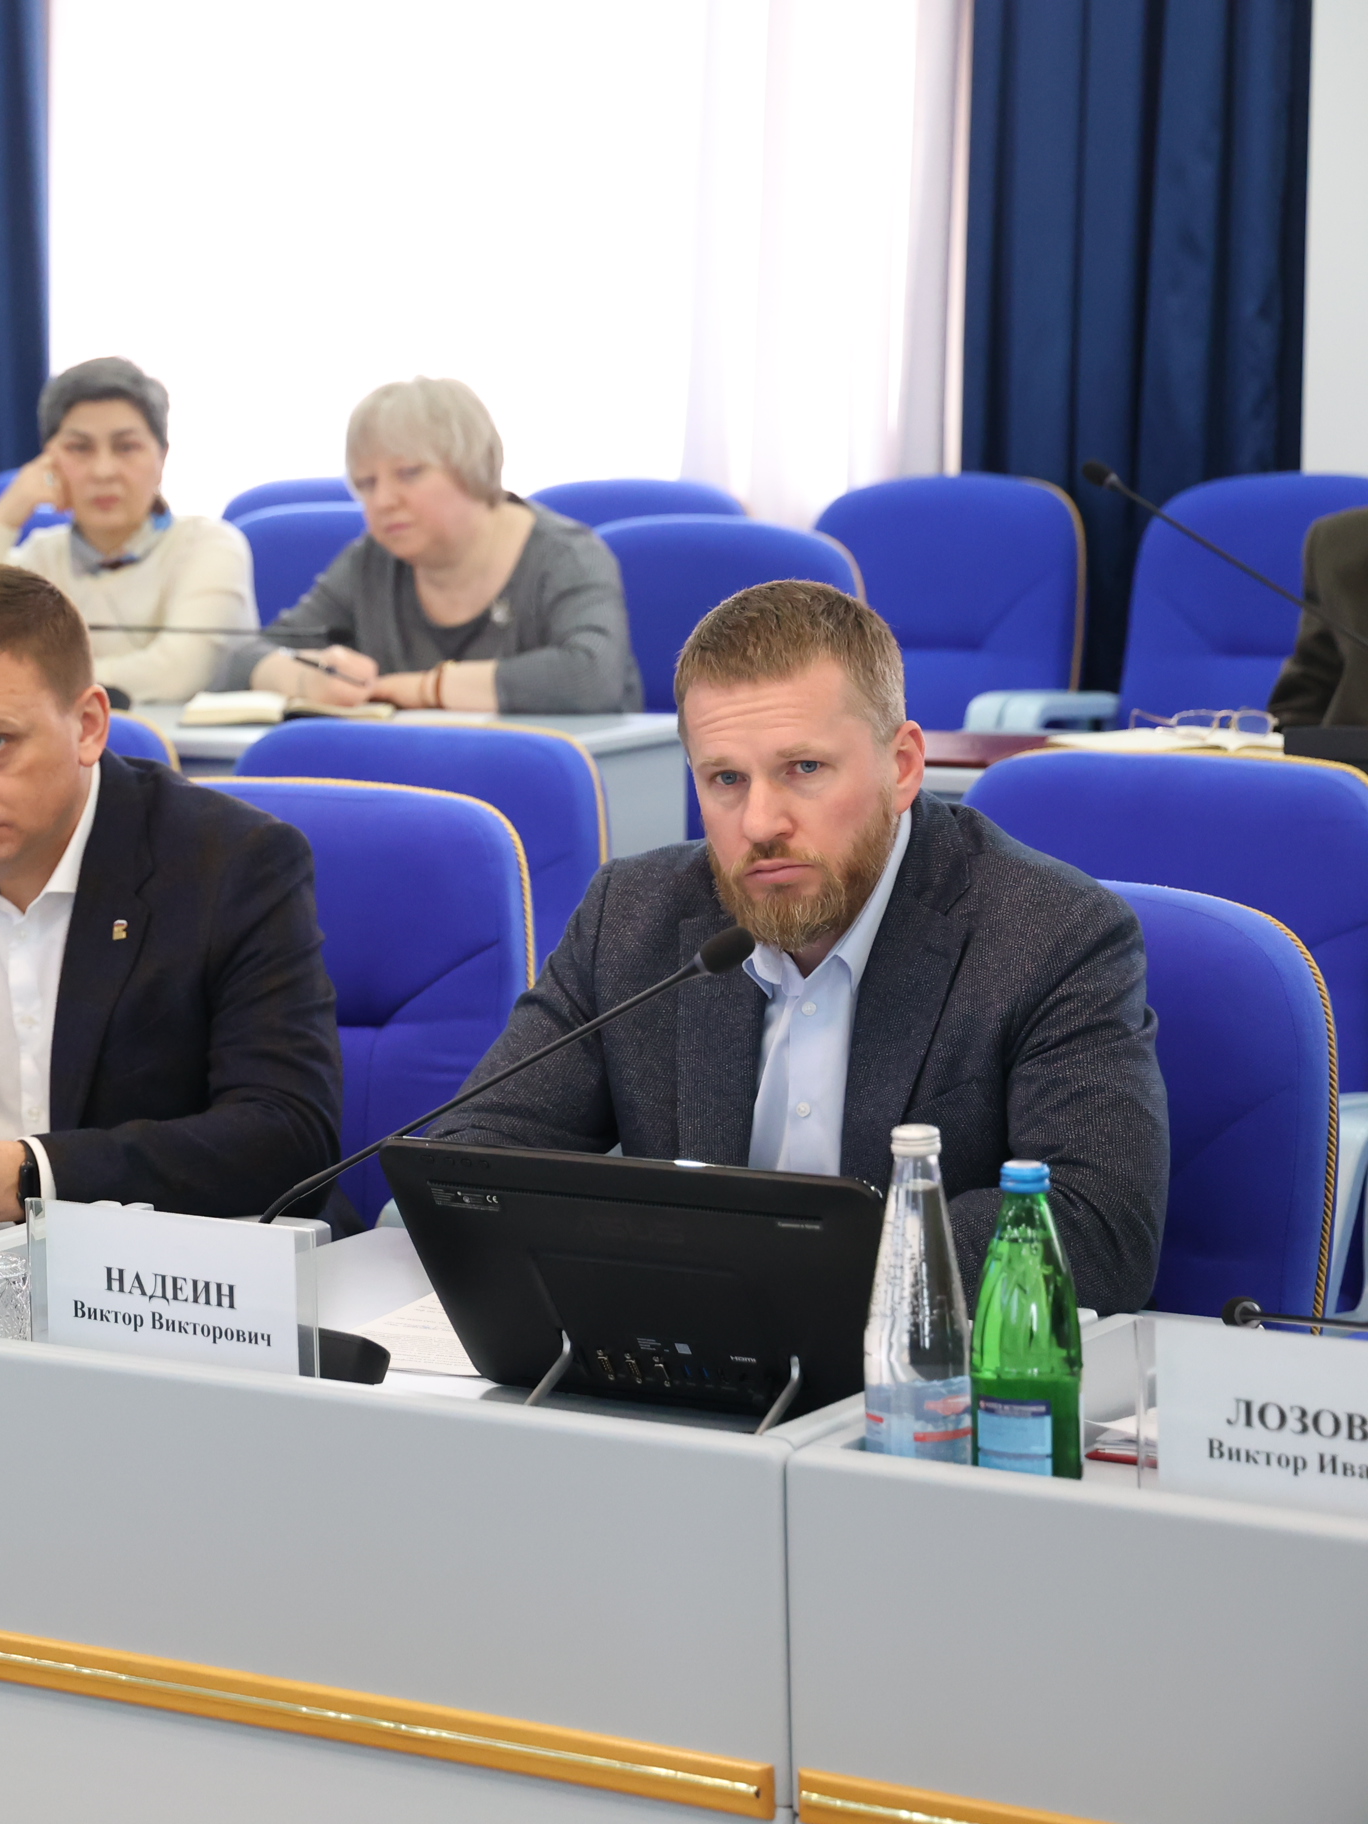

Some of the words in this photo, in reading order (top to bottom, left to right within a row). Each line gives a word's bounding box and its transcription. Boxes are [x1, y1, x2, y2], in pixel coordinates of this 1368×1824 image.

[104, 1266, 237, 1310] НАДЕИН
[73, 1299, 145, 1332] Виктор
[150, 1310, 272, 1347] Викторович
[1226, 1397, 1368, 1441] ЛОЗОВ
[1207, 1437, 1308, 1477] Виктор
